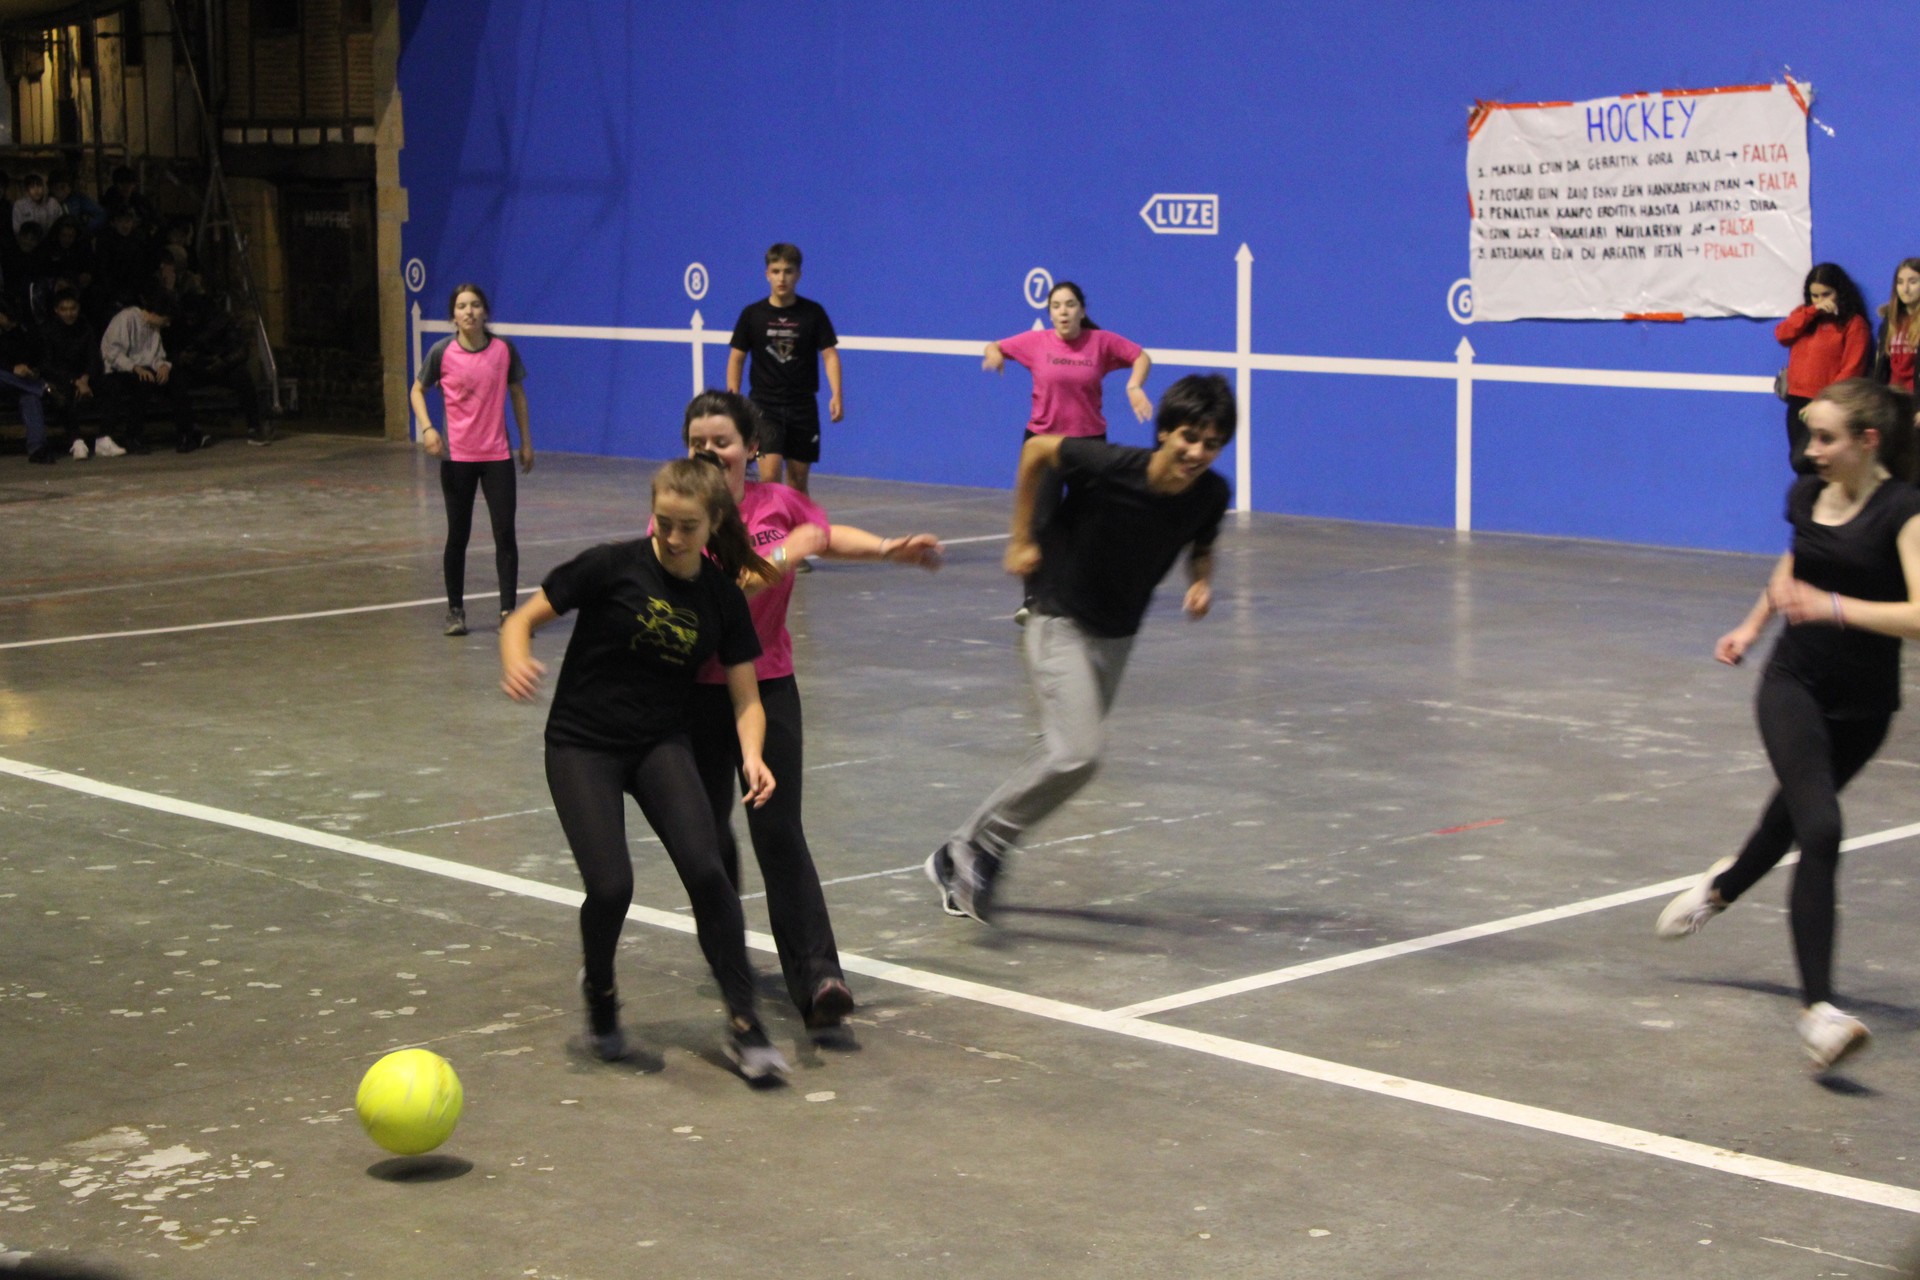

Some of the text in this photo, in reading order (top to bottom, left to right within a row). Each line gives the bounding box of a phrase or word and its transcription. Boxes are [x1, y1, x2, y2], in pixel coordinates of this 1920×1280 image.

[1586, 98, 1697, 143] HOCKEY
[1491, 163, 1533, 177] MAKILA
[1566, 159, 1580, 172] DA
[1587, 154, 1639, 171] GERRITIK
[1647, 151, 1673, 166] GORA
[1685, 148, 1721, 165] ALTXA
[1742, 143, 1789, 164] FALTA
[1758, 171, 1798, 192] FALTA
[1156, 202, 1212, 225] LUZE
[1490, 206, 1550, 219] PENALTIAK
[1597, 204, 1636, 218] ERDITIK
[1749, 199, 1778, 212] DIRA
[1719, 218, 1755, 236] FALTA
[1704, 242, 1756, 260] PENALTI
[411, 266, 420, 284] 9
[692, 272, 702, 291] 8
[1033, 277, 1044, 299] 7
[1459, 290, 1472, 313] 6
